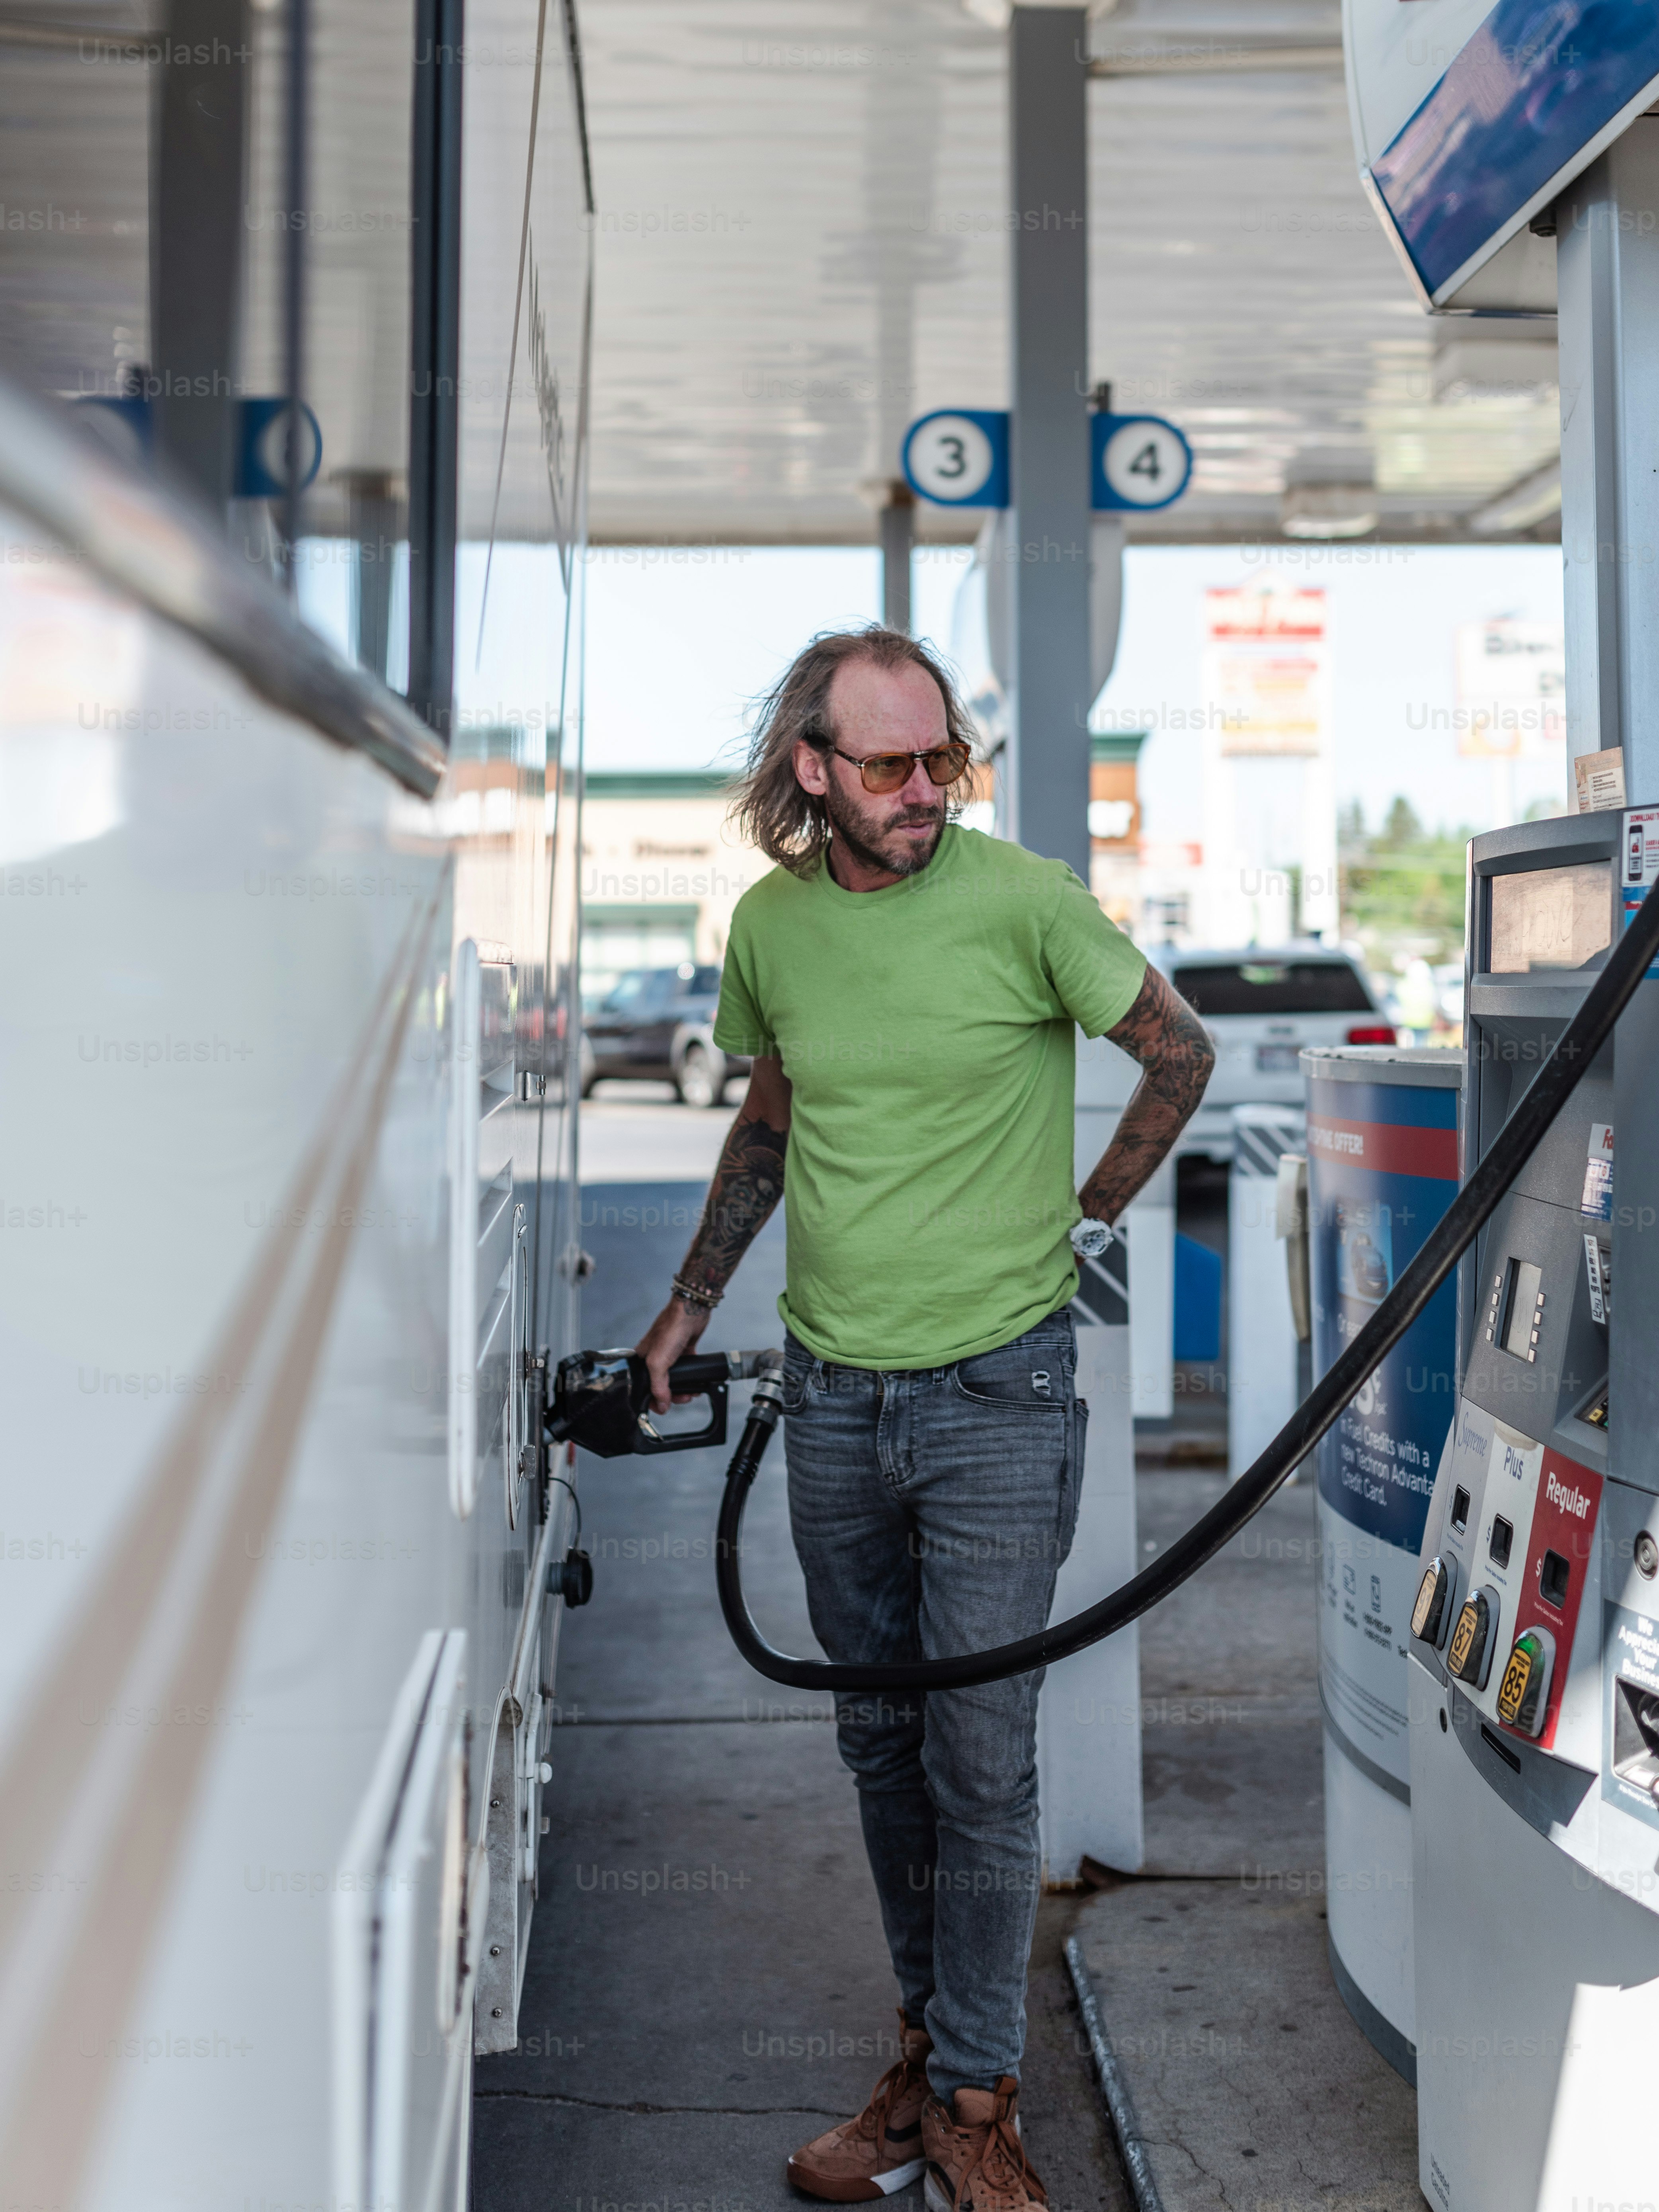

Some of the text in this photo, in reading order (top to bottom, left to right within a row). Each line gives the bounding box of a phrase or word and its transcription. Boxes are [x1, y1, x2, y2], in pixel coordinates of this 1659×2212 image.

[935, 436, 966, 478] 3
[1129, 442, 1161, 482] 4
[1335, 1131, 1364, 1155] OFFER!
[1363, 1425, 1396, 1456] Credits
[1397, 1440, 1420, 1465] with
[1422, 1451, 1430, 1468] a
[1458, 1412, 1487, 1457] Supreme
[1356, 1447, 1390, 1481] Techron
[1503, 1445, 1524, 1480] Plus
[1341, 1465, 1363, 1495] Credit
[1546, 1471, 1591, 1519] Regular
[1486, 1525, 1491, 1543] $
[1535, 1558, 1542, 1577] $
[1417, 1587, 1431, 1621] 91
[1454, 1622, 1472, 1657] 87
[1638, 1616, 1653, 1636] We
[1634, 1646, 1657, 1670] Your
[1504, 1666, 1526, 1704] 85
